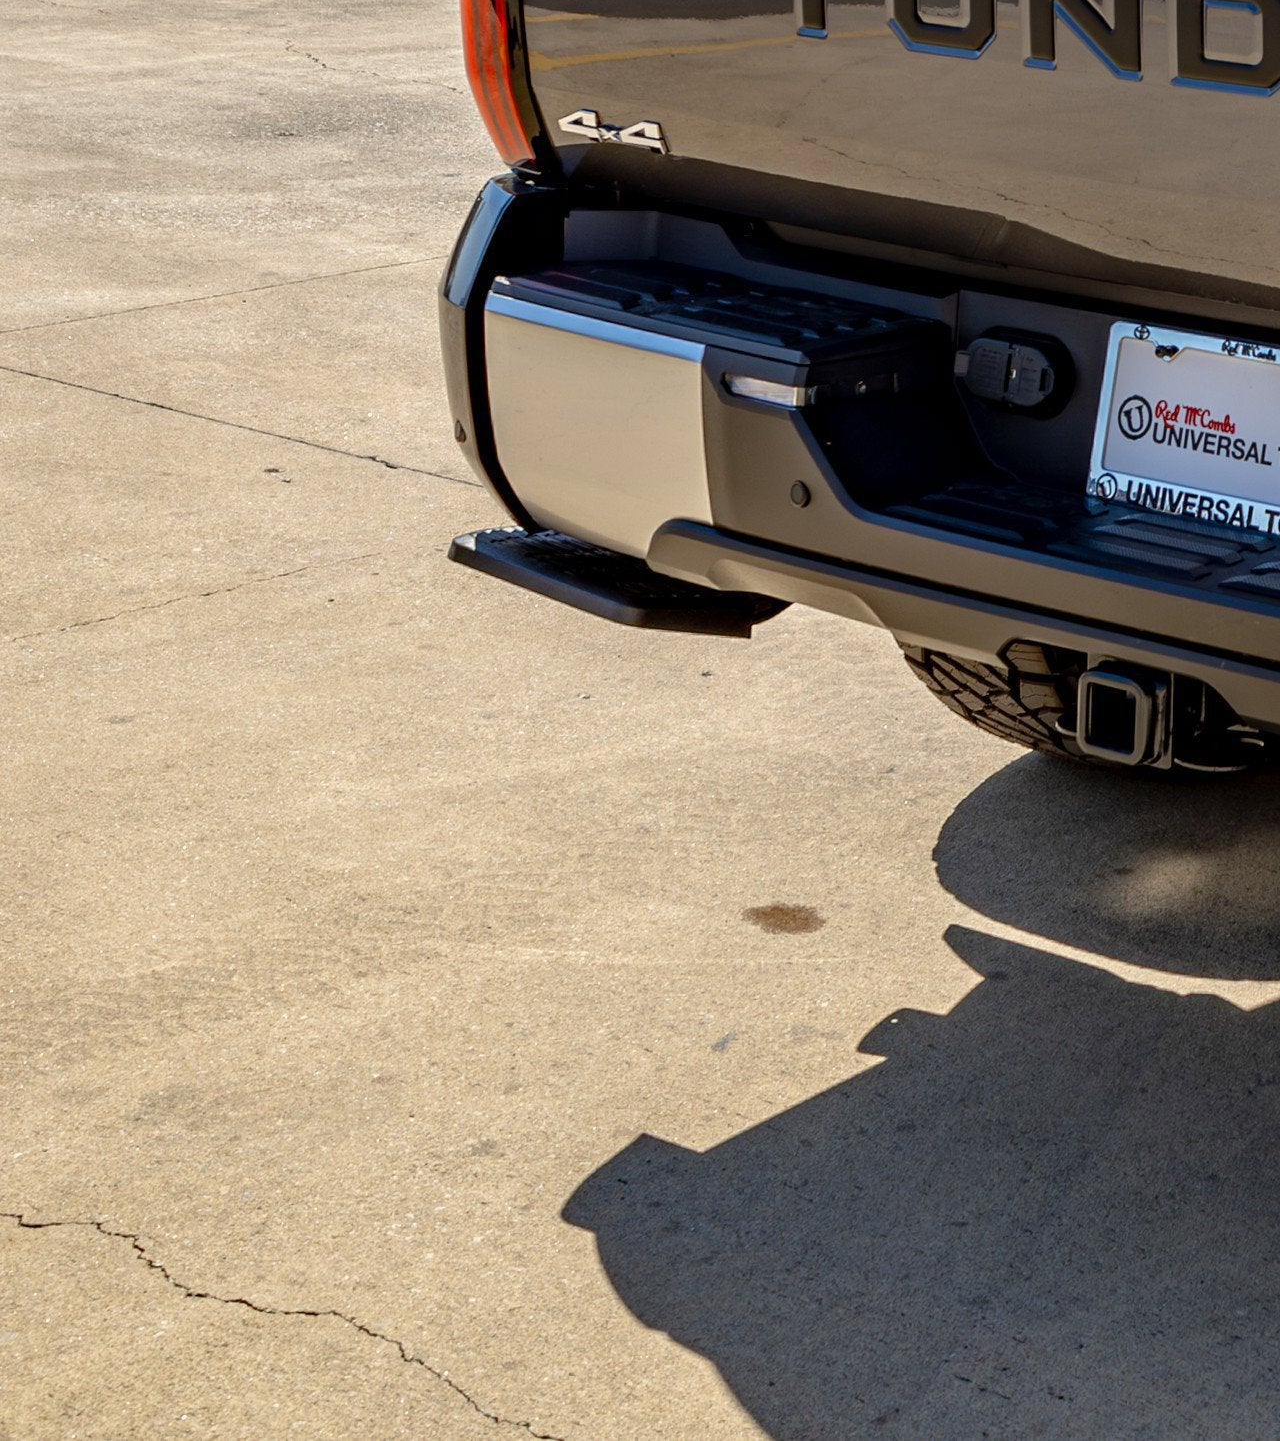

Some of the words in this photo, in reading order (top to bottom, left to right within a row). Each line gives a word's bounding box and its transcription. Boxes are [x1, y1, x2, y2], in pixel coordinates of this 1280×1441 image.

[1155, 399, 1180, 428] Red
[1183, 405, 1236, 435] McCombs
[1152, 422, 1272, 466] UNIVERSAL
[1126, 479, 1260, 531] UNIVERSAL
